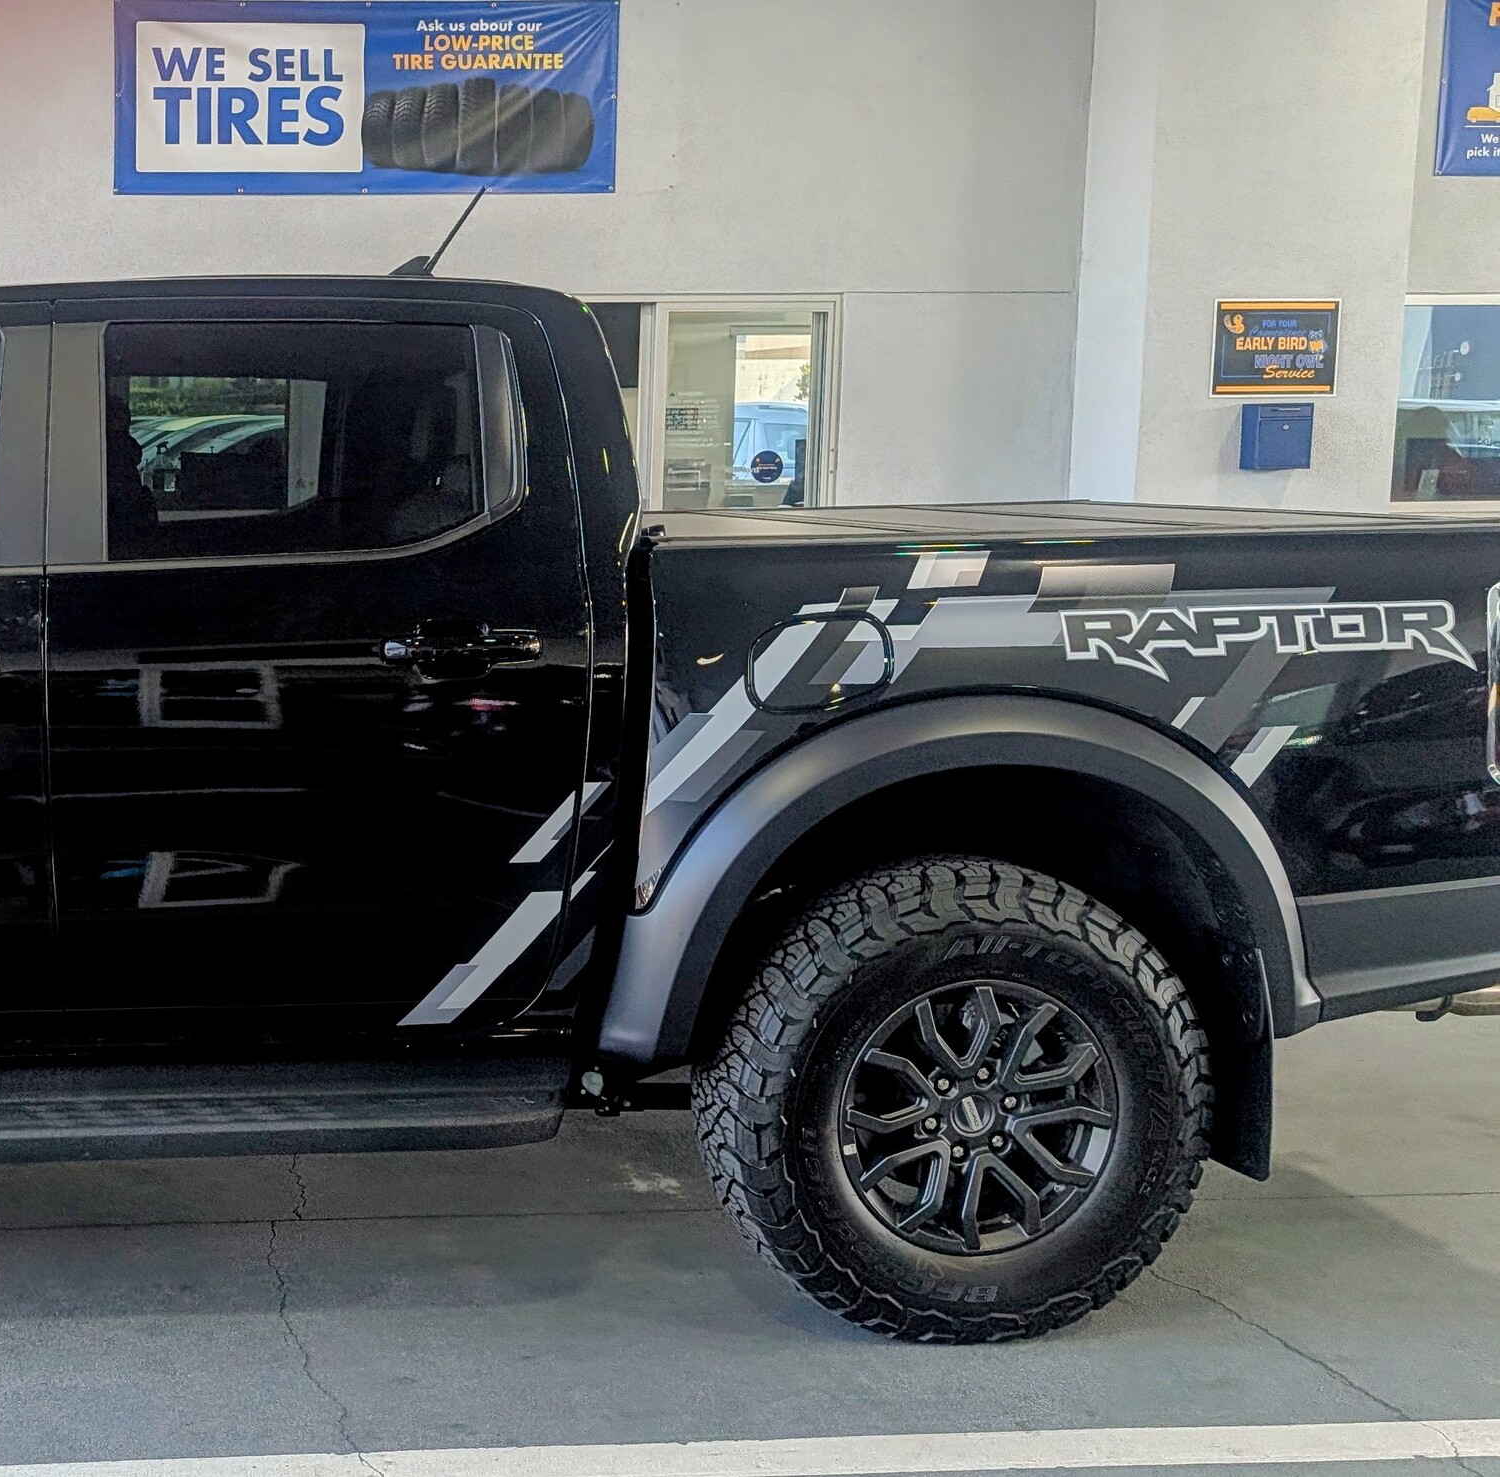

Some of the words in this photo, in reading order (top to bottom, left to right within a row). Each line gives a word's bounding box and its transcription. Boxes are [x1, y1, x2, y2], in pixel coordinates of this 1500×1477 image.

[416, 20, 445, 32] Ask
[449, 22, 466, 32] us
[470, 18, 514, 32] about
[517, 21, 543, 32] our
[424, 34, 535, 51] LOW-PRICE
[152, 47, 226, 82] WE
[247, 47, 344, 82] SELL
[392, 53, 435, 70] TIRE
[440, 53, 565, 71] GUARANTEE
[153, 85, 345, 147] TIRES
[1480, 133, 1500, 144] We
[1466, 146, 1490, 159] pick
[1236, 337, 1275, 350] EARLY
[1278, 336, 1307, 350] BIRD
[1254, 353, 1294, 369] NIGHT
[1295, 353, 1324, 369] OWL
[1262, 364, 1316, 379] Service
[1058, 599, 1478, 682] RAPTOR
